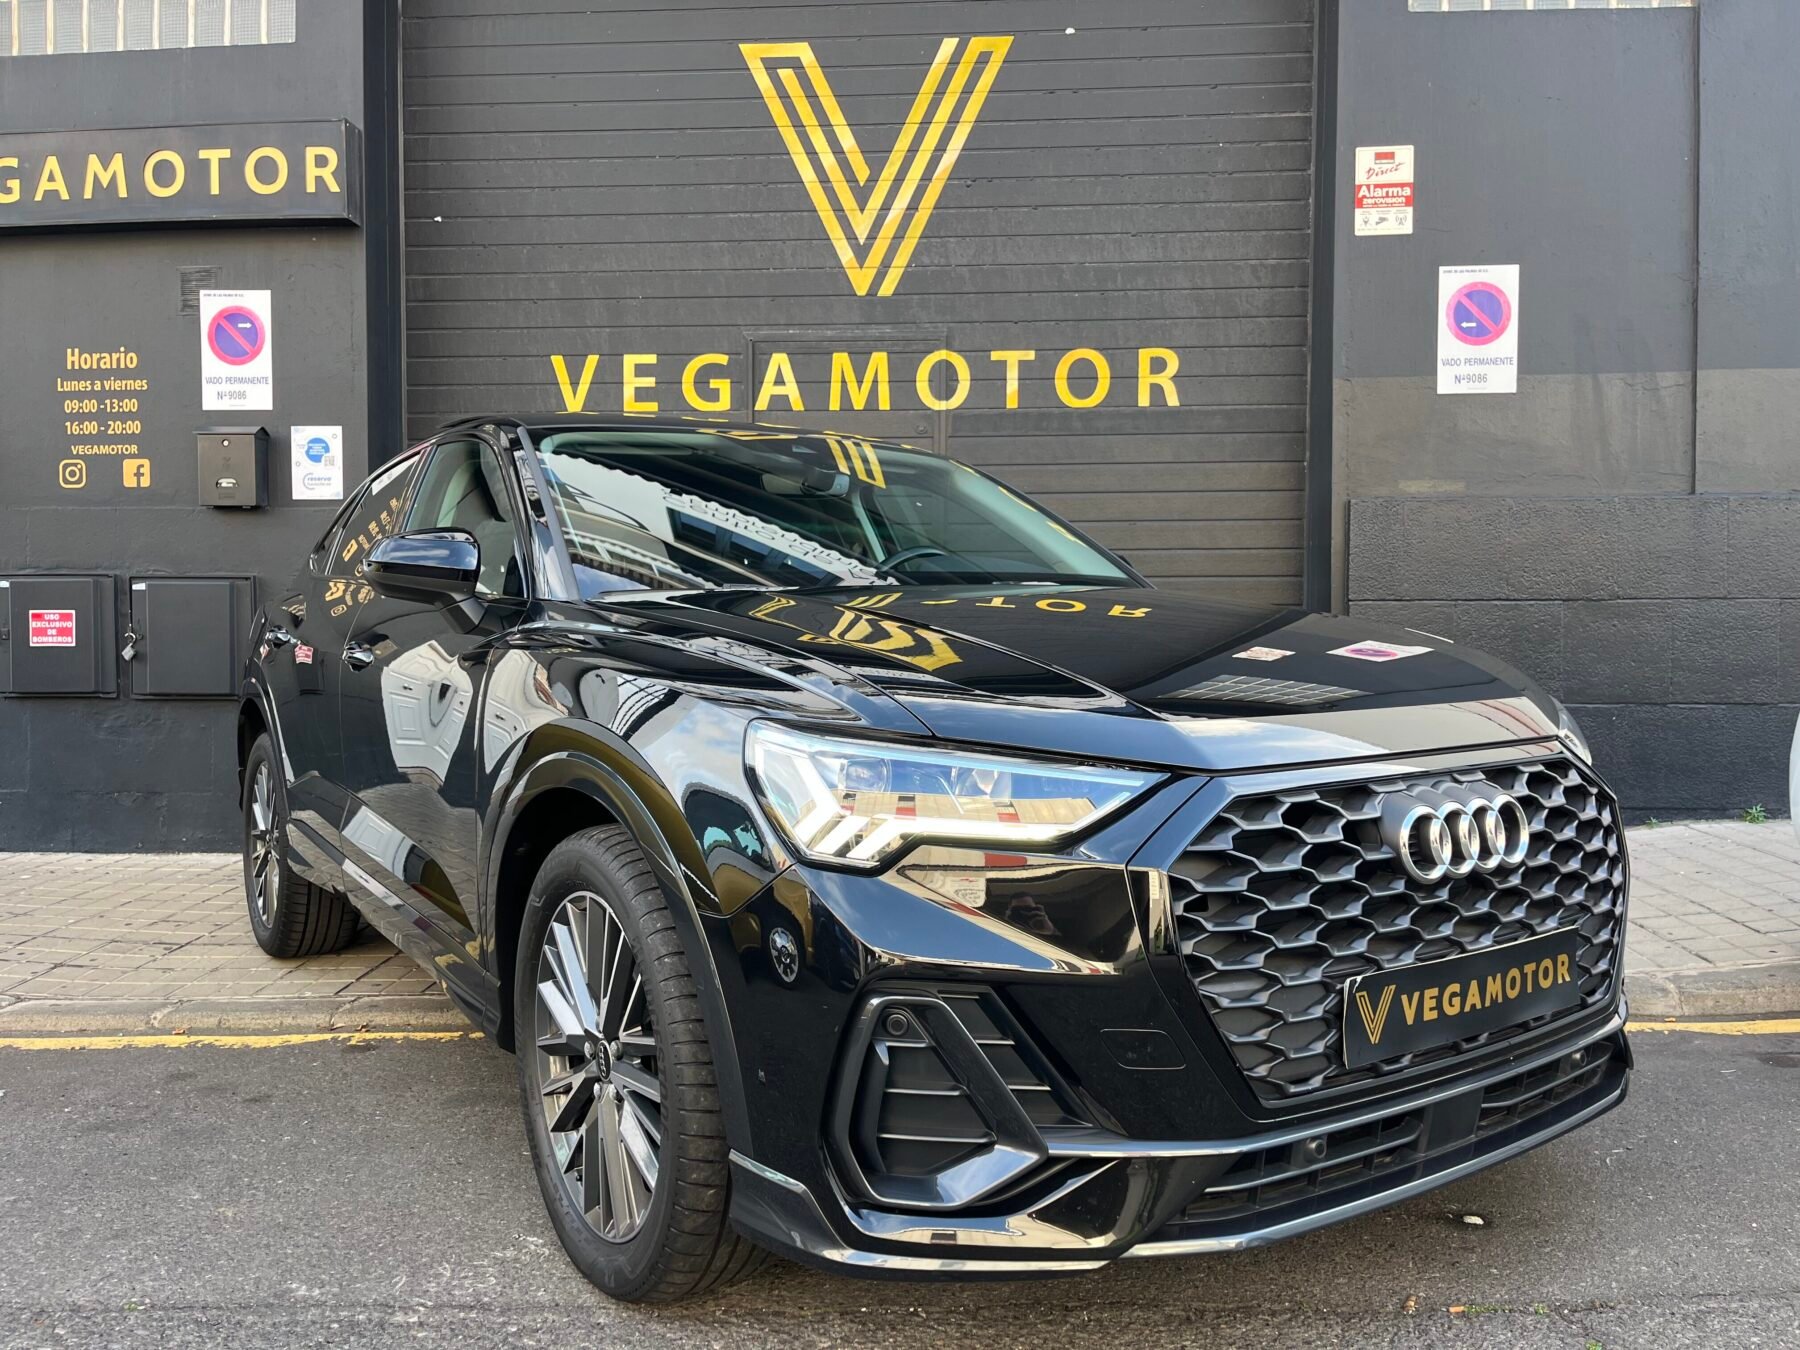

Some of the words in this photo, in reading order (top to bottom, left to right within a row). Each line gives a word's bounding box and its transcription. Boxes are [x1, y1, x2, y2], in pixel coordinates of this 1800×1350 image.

[1358, 184, 1411, 198] Alarma
[66, 346, 139, 370] Horario
[1441, 357, 1462, 367] VADO
[1464, 356, 1515, 367] PERMANENTE
[57, 377, 92, 392] Lunes
[93, 380, 102, 391] a
[103, 376, 149, 391] viernes
[205, 376, 223, 385] VADO
[225, 376, 270, 385] PERMANENTE
[550, 347, 1181, 412] VEGAMOTOR
[64, 399, 98, 413] 09:00
[64, 420, 98, 435] 16:00
[107, 420, 142, 435] 20:00
[71, 444, 139, 455] VEGAMOTOR
[1401, 953, 1571, 1026] VEGAMOTOR
